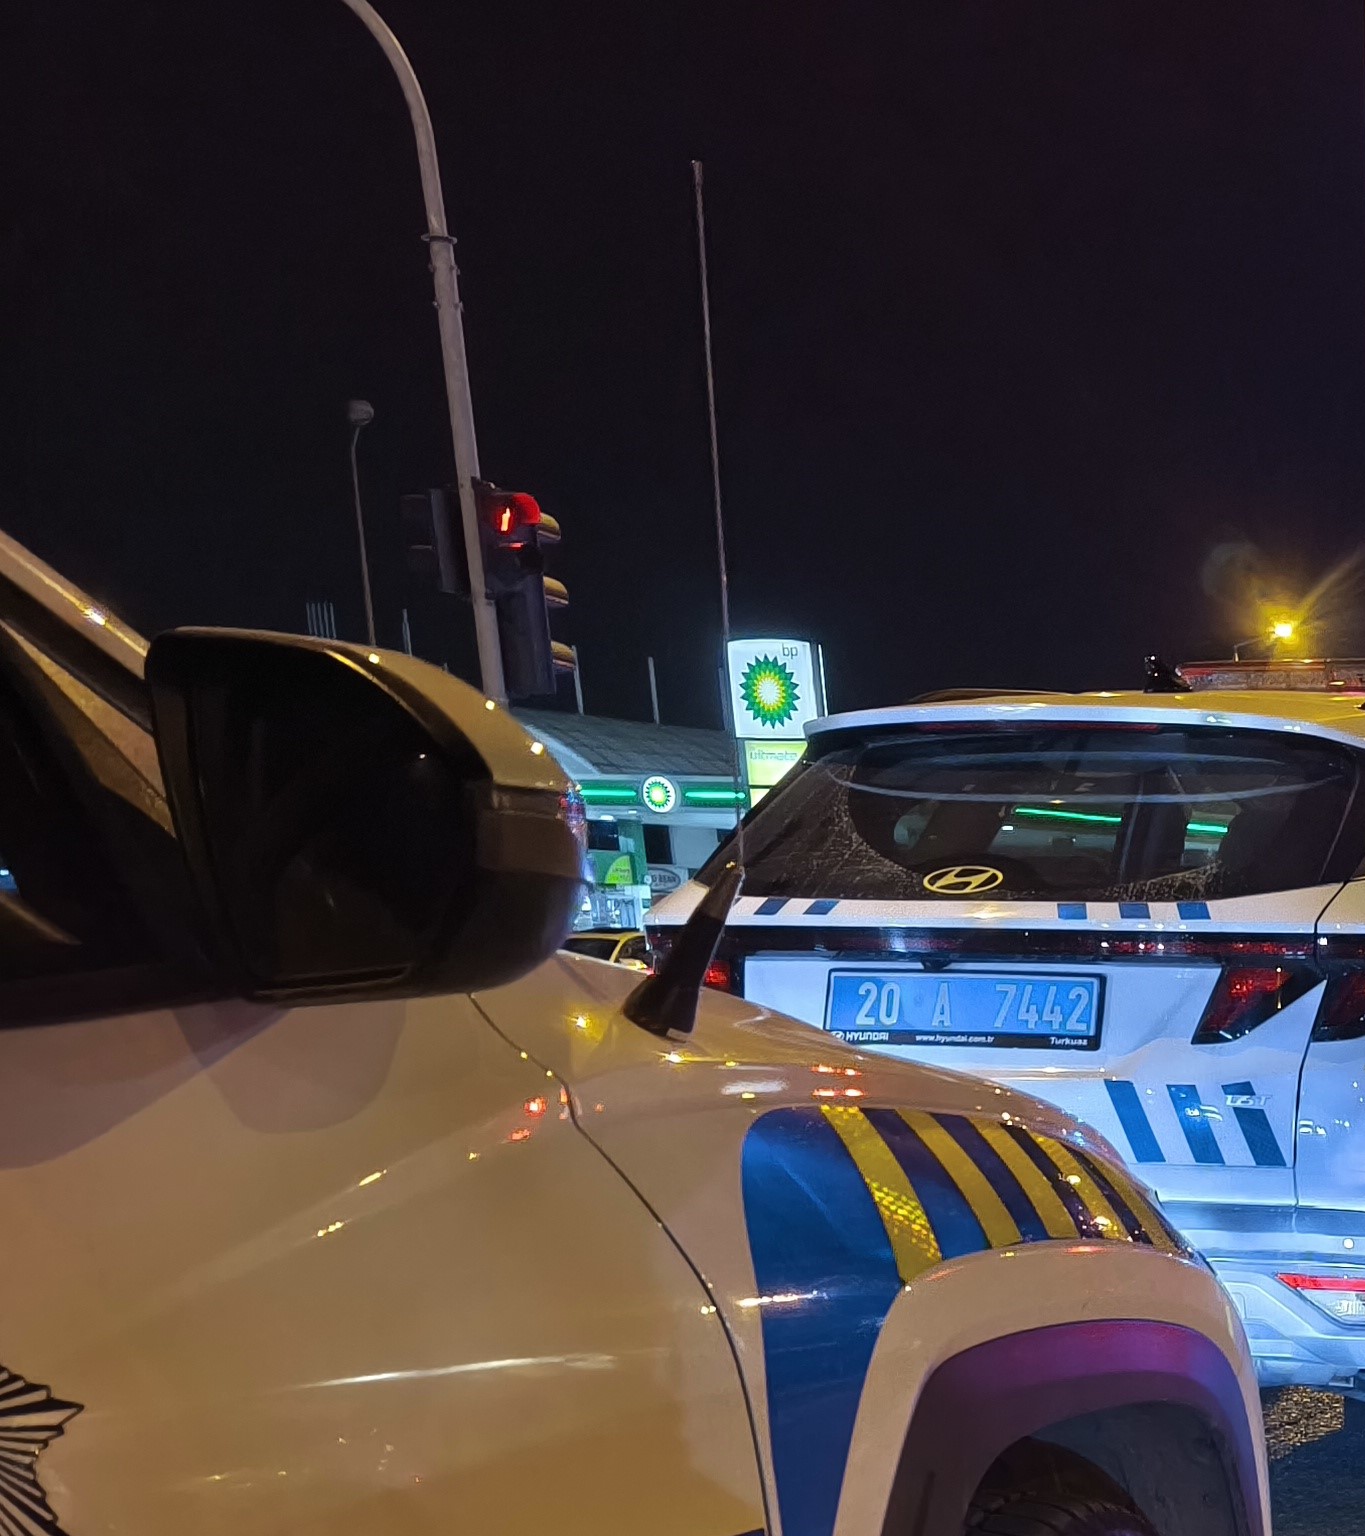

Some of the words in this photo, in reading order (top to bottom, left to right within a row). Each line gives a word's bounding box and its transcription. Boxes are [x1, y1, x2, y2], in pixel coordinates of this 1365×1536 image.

[782, 643, 798, 659] bp
[855, 981, 900, 1026] 20
[931, 982, 952, 1027] A
[994, 983, 1090, 1032] 7442
[846, 1032, 889, 1042] HYUNDAI
